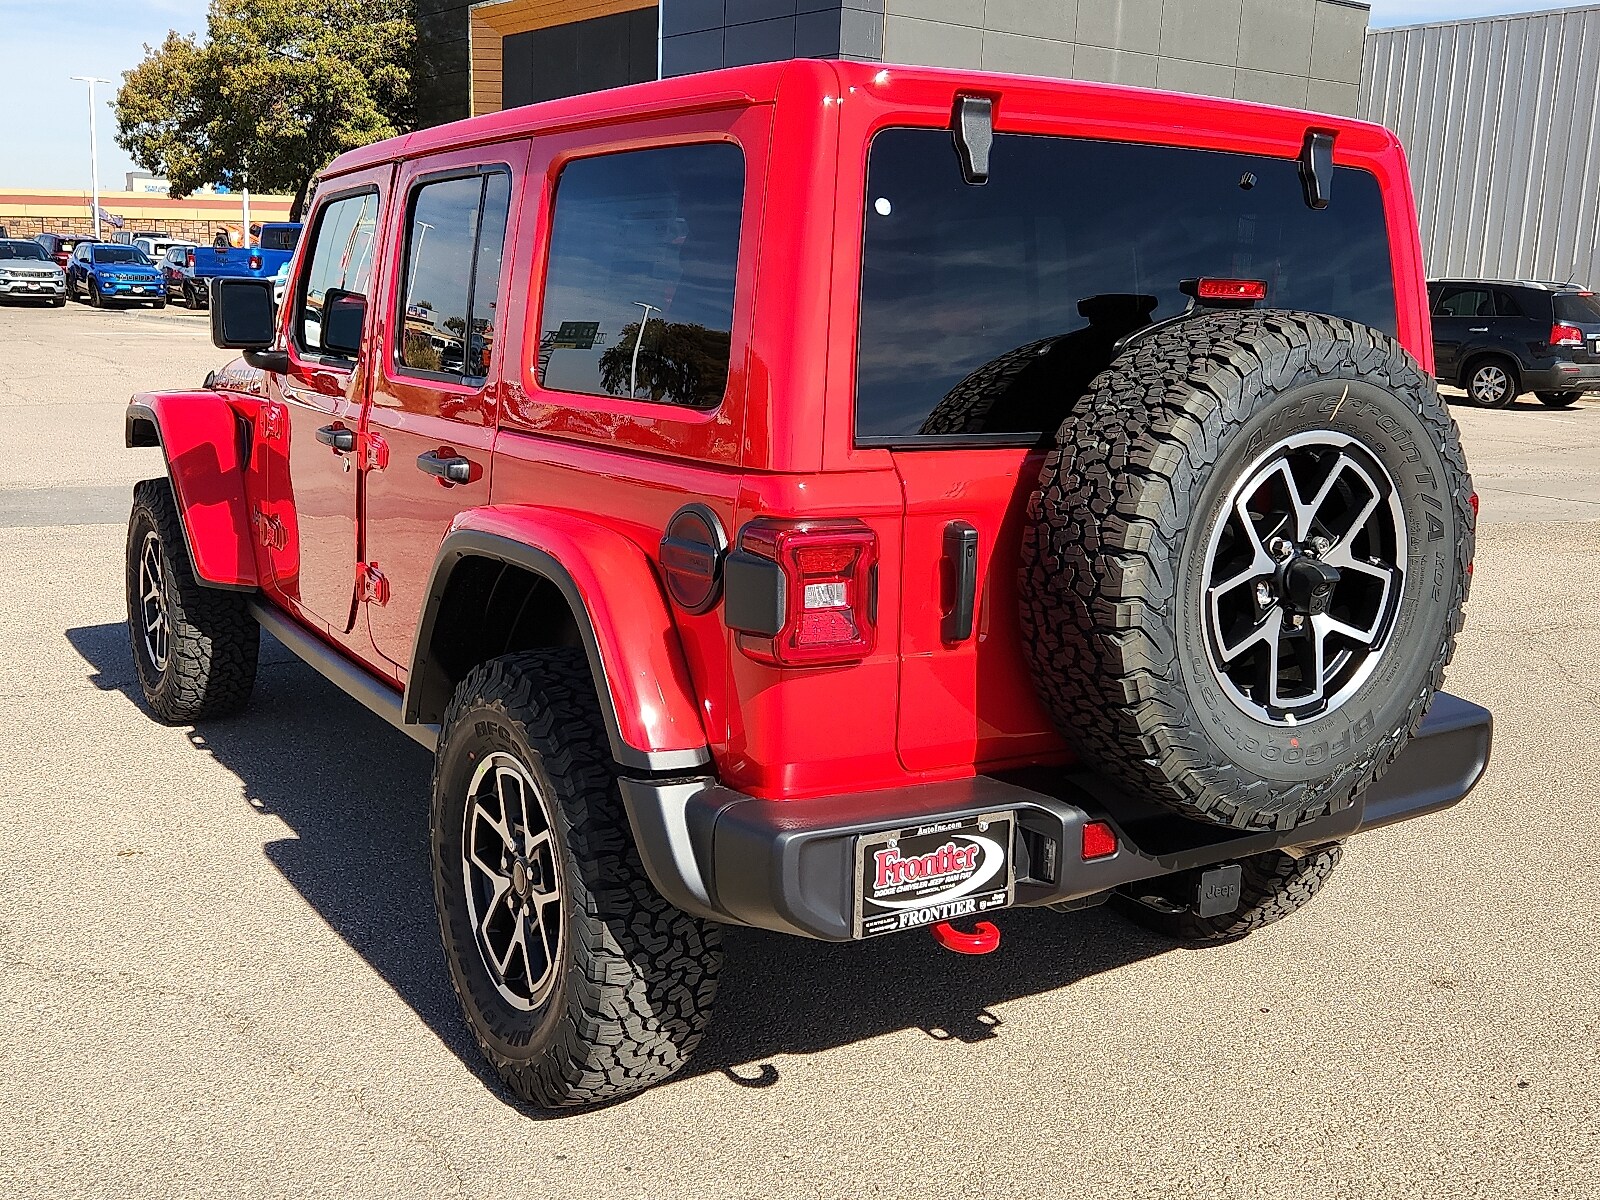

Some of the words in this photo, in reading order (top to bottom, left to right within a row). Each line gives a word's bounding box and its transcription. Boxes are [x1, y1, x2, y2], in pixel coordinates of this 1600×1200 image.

[1241, 393, 1423, 465] All-Terrain
[1414, 464, 1446, 543] T/A
[1191, 656, 1377, 767] BFGoodrich
[917, 821, 962, 836] AutoInc.com
[874, 843, 979, 889] Frontier
[873, 887, 897, 898] DODGE
[896, 881, 928, 894] CHRYSLER
[1205, 884, 1235, 899] Jeep
[898, 898, 977, 929] FRONTIER
